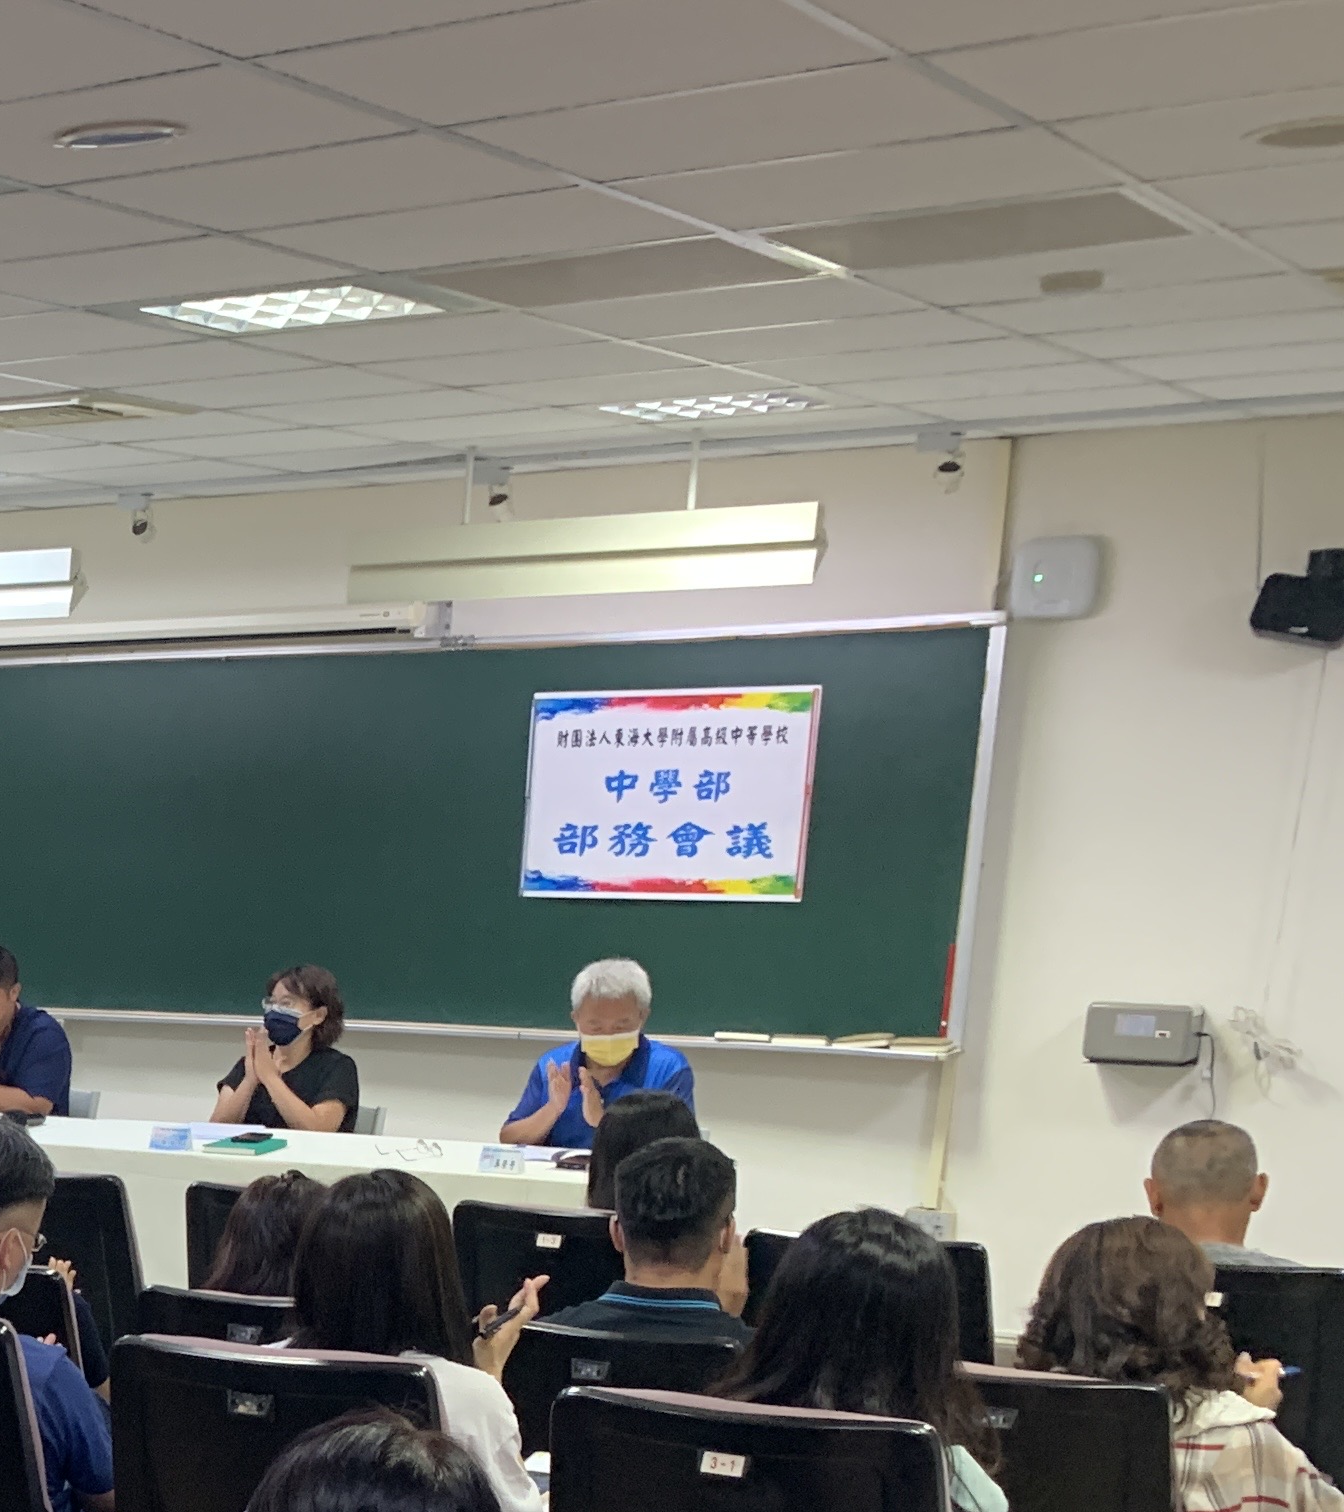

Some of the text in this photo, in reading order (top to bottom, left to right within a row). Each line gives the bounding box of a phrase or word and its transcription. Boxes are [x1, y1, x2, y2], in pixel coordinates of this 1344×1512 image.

[556, 724, 790, 749] 財團法人東海大學附屬高級中等學校
[604, 768, 732, 804] 中學部
[552, 821, 775, 859] 部務會議
[710, 1456, 736, 1473] 3-1
